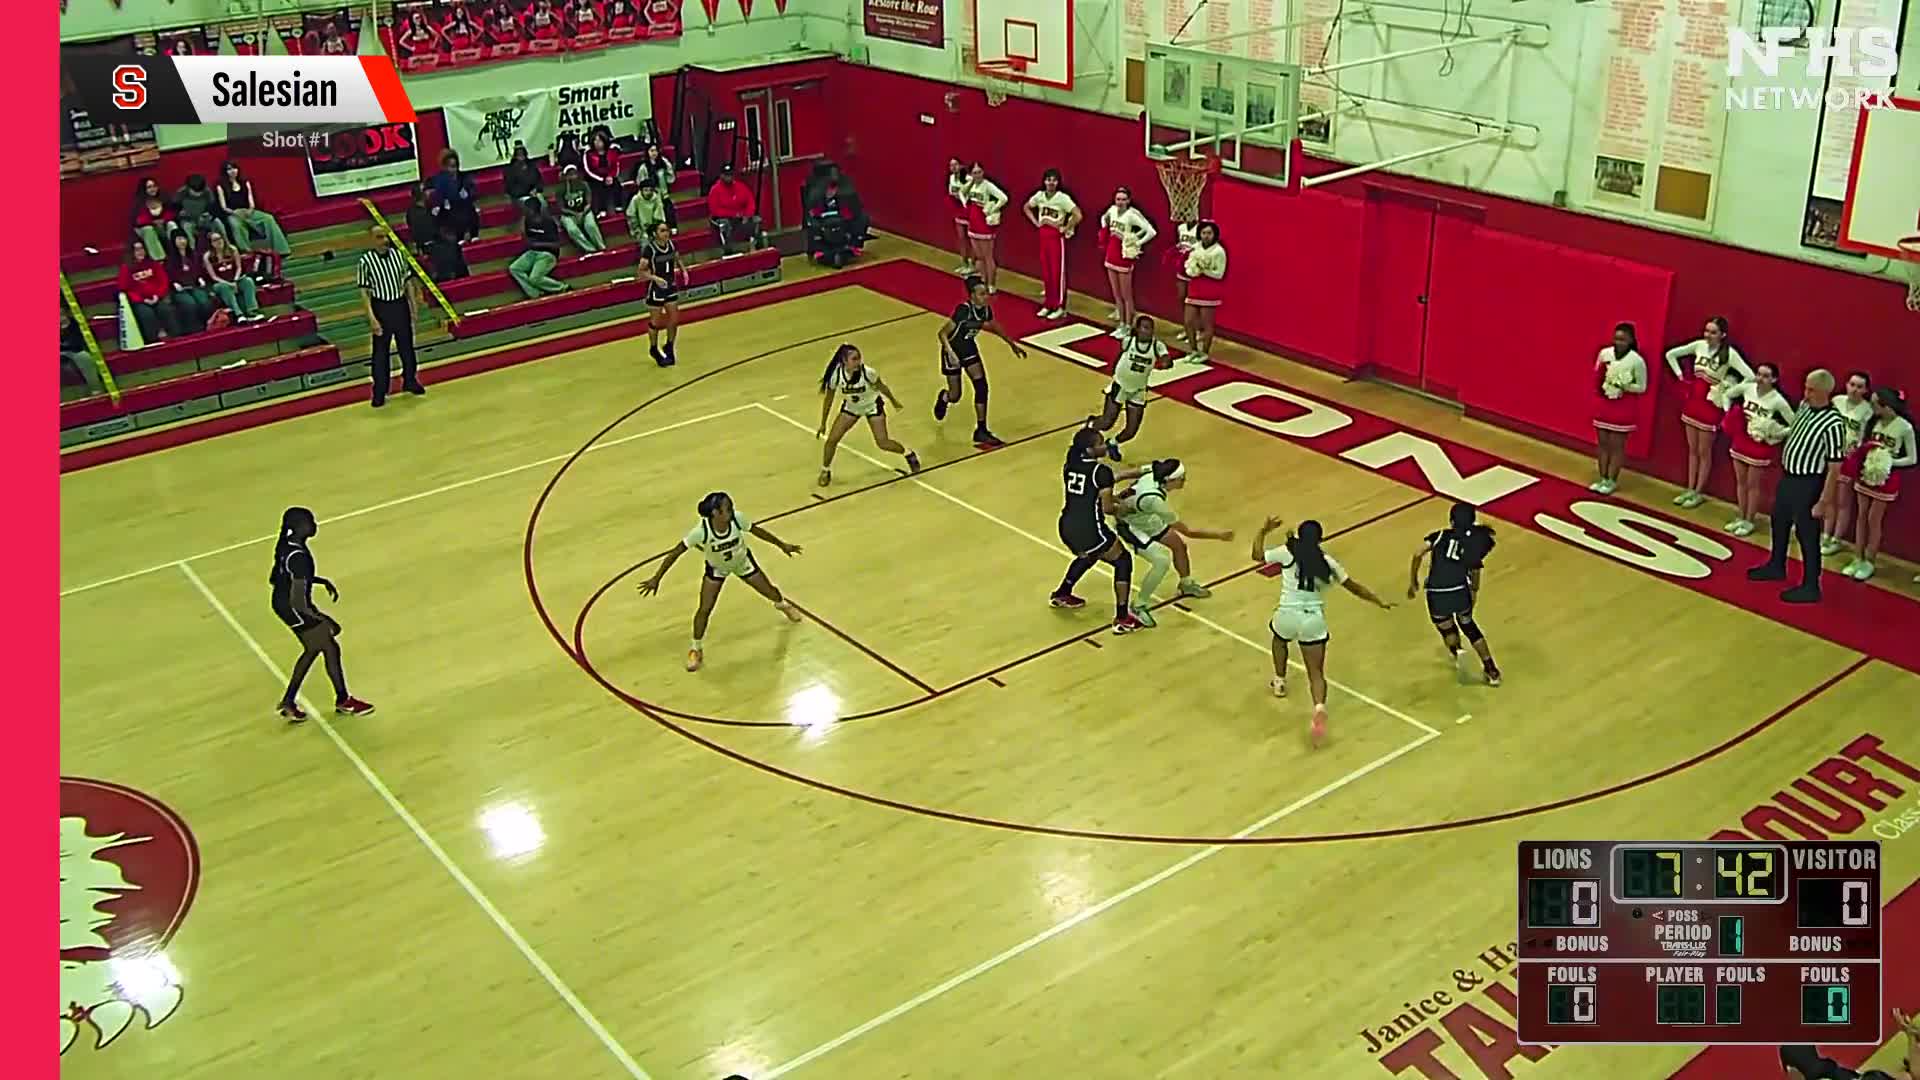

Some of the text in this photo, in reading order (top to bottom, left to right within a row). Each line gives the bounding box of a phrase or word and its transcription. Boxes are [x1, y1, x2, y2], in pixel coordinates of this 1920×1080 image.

[917, 1, 939, 16] Roar
[558, 80, 620, 106] Smart
[558, 100, 634, 128] Athletic
[1020, 322, 1732, 580] LIONS
[1067, 471, 1086, 495] 23
[1706, 733, 1920, 840] OURT
[1360, 990, 1453, 1054] Janice
[1452, 968, 1484, 993] &
